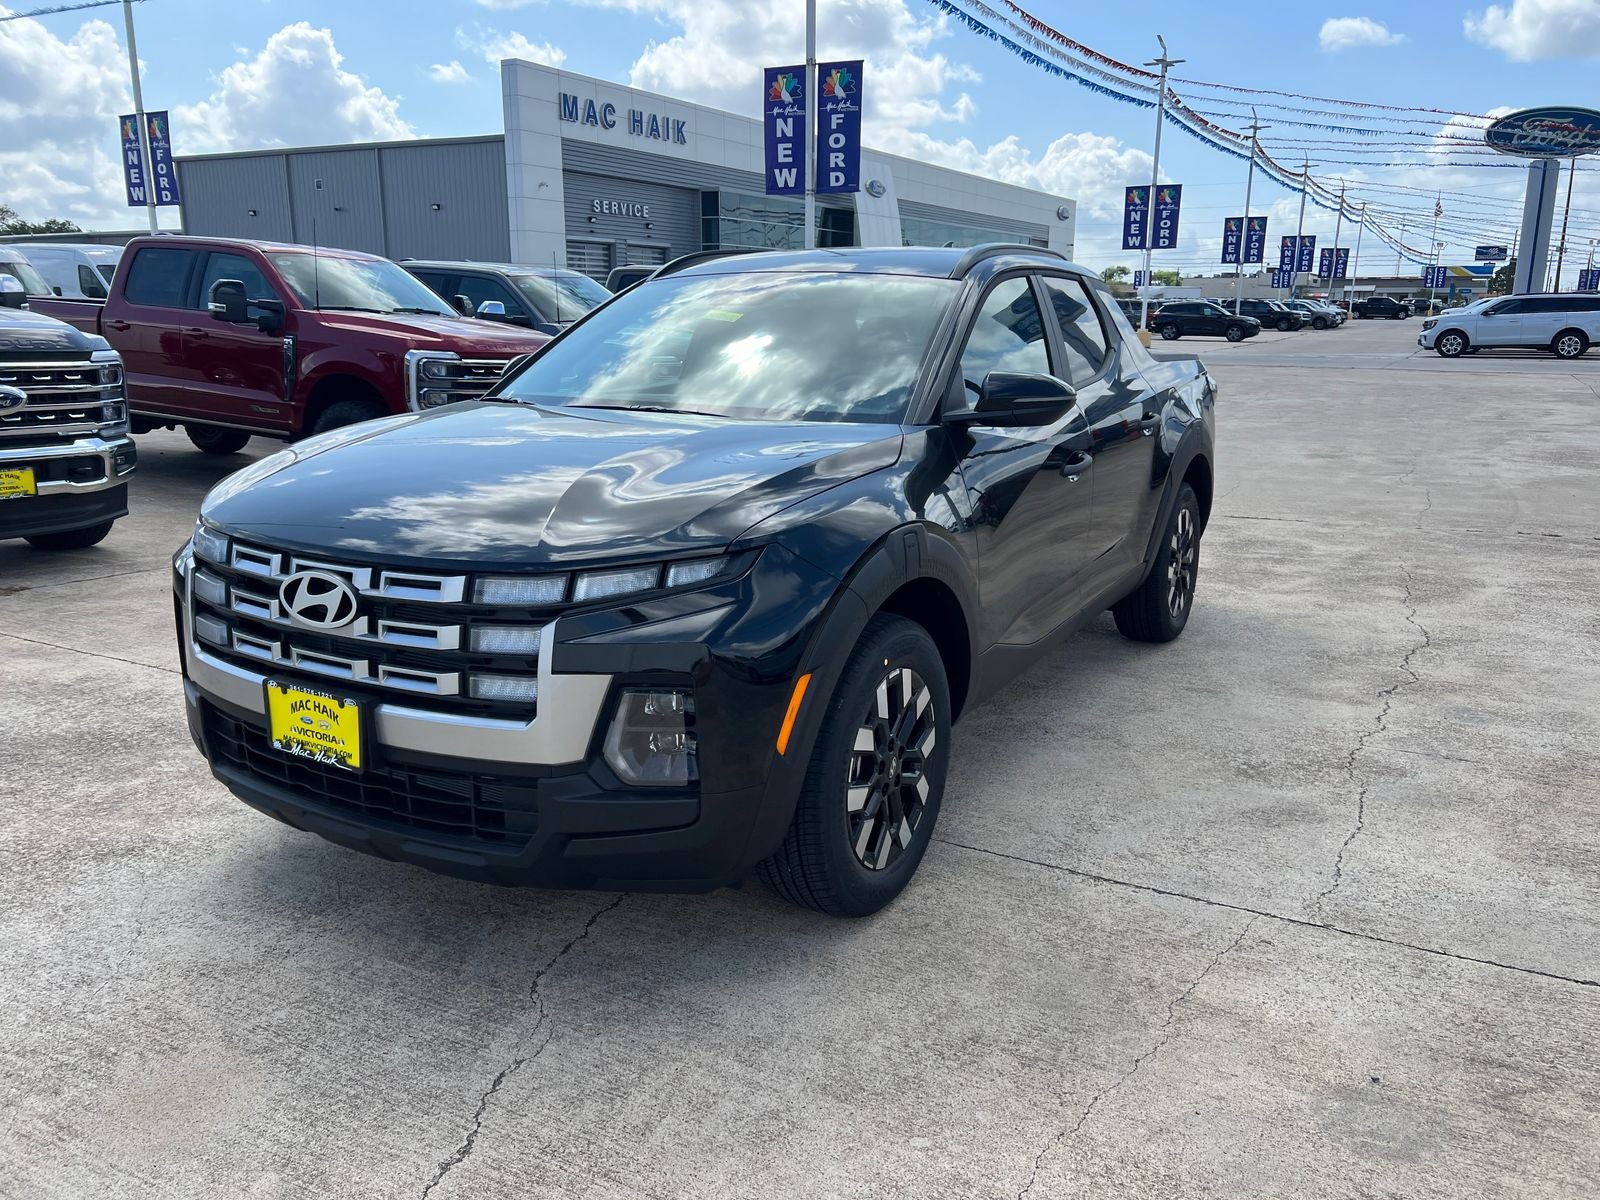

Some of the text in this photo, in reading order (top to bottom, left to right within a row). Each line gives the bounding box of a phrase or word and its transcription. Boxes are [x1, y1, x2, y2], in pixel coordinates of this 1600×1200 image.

[560, 92, 687, 144] MAC HAIK
[774, 118, 797, 188] NEW
[828, 113, 846, 187] FORD
[128, 151, 144, 201] NEW
[156, 150, 172, 202] FORD
[593, 199, 649, 218] SERVICE
[1128, 211, 1141, 247] NEW
[1159, 210, 1171, 247] FORD
[1226, 235, 1236, 262] NEW
[1249, 235, 1259, 262] FORD
[1282, 250, 1291, 271] NEW
[1302, 249, 1310, 271] FORD
[1321, 260, 1329, 277] NEW
[290, 699, 340, 727] MAC HAIK
[296, 726, 339, 746] VICTORIA
[289, 743, 313, 759] Mac
